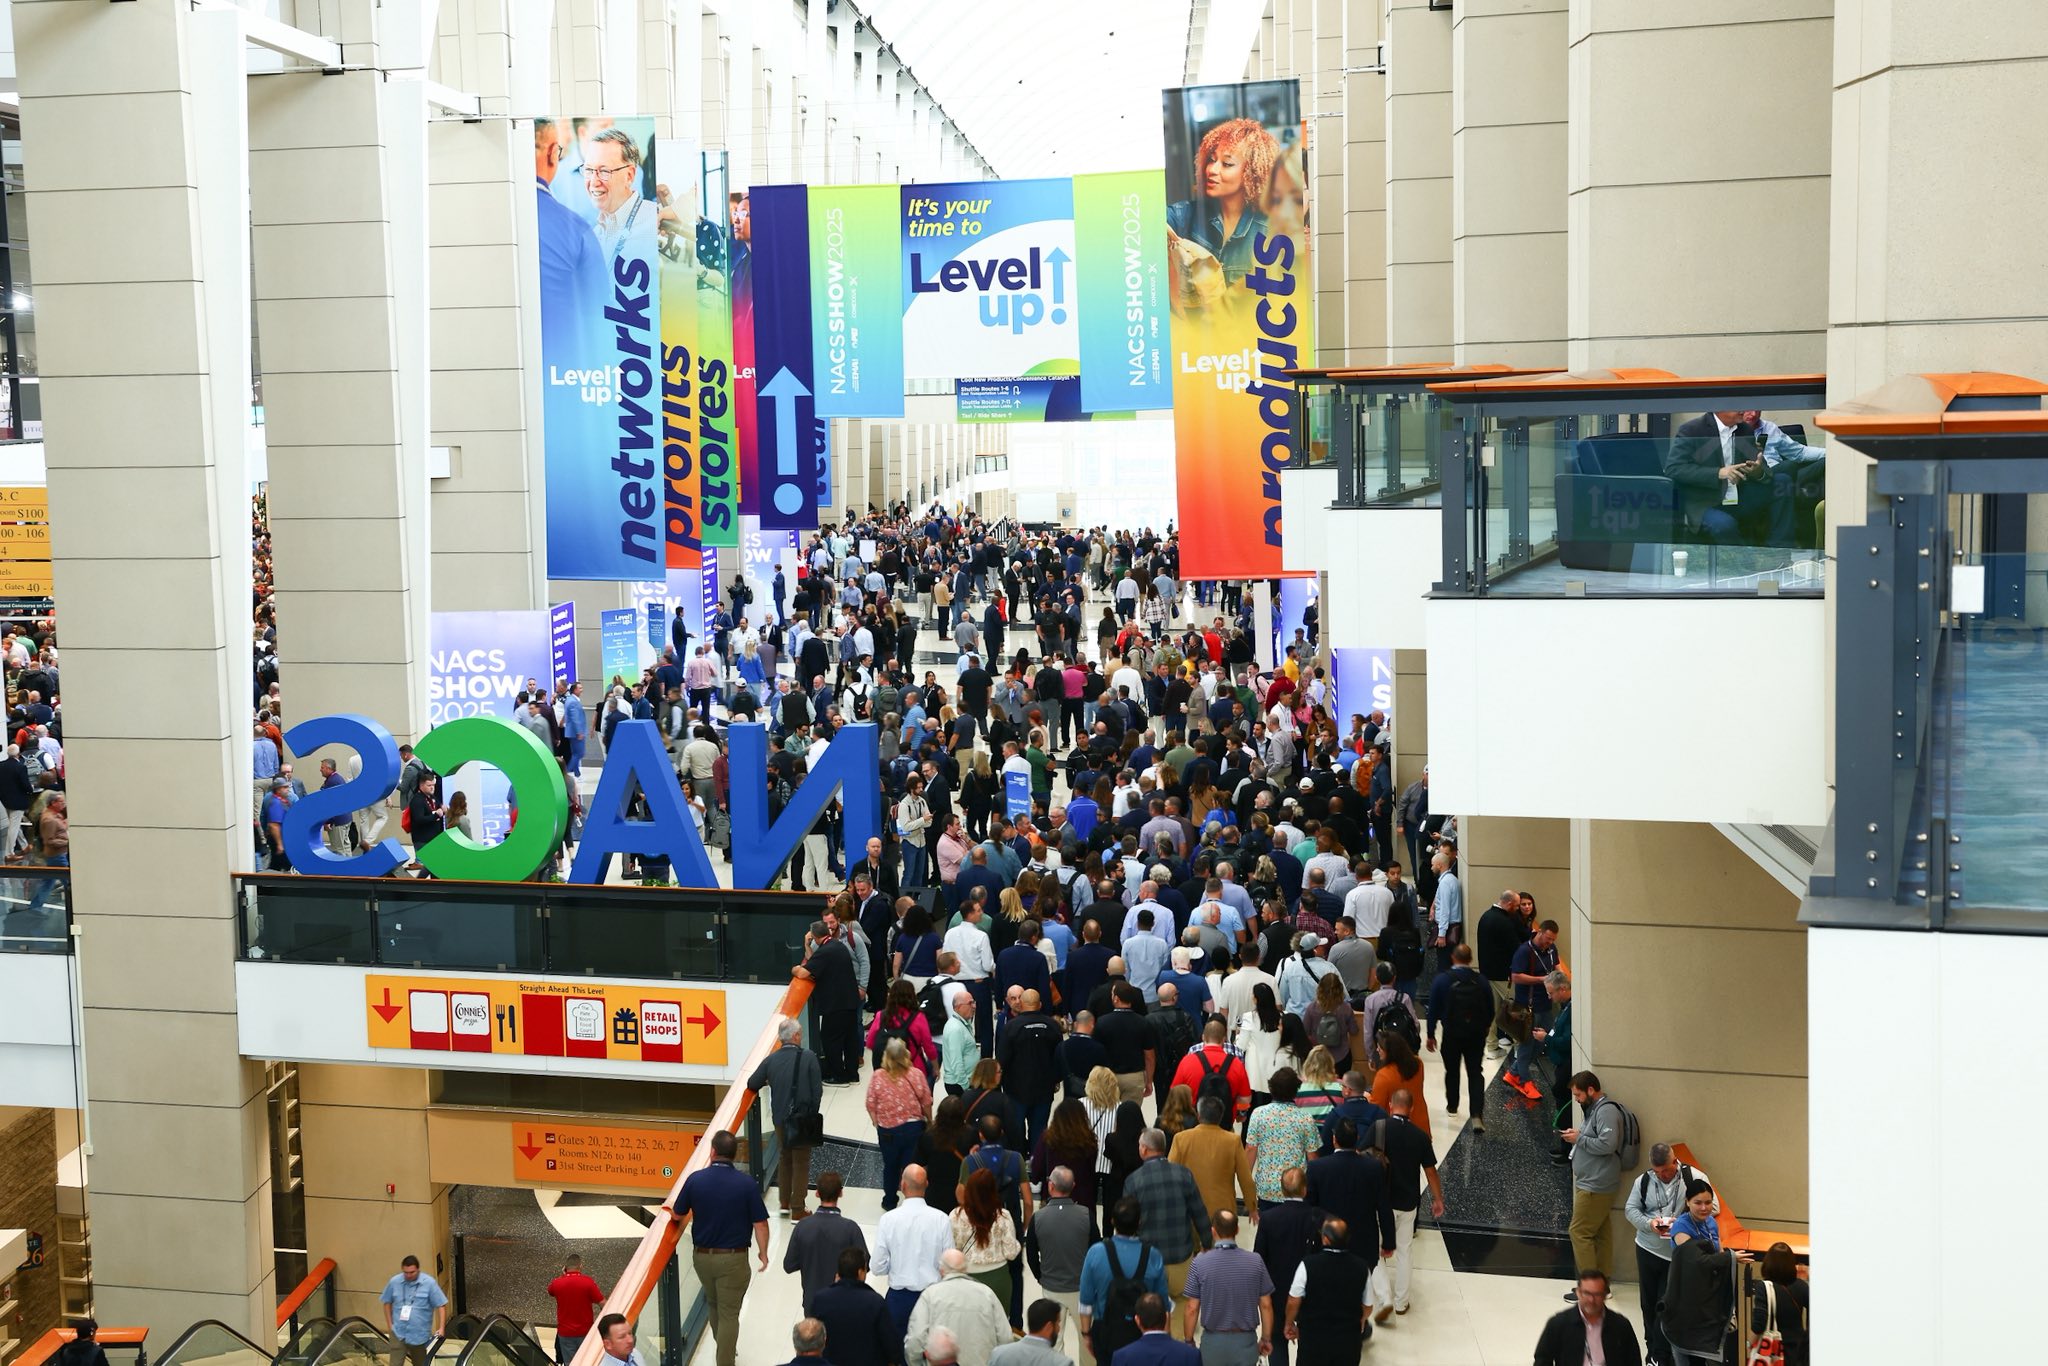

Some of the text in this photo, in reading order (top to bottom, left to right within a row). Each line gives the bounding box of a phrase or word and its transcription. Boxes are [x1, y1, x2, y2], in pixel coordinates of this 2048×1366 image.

[908, 198, 992, 218] It's your
[909, 218, 982, 237] time to
[910, 246, 1041, 293] Level
[1181, 348, 1249, 373] Level
[549, 364, 610, 386] Level
[603, 253, 657, 564] networks
[699, 355, 731, 531] stores
[10, 491, 19, 501] C
[17, 509, 44, 519] S100
[26, 529, 45, 538] 106
[5, 583, 25, 591] Gates
[27, 583, 40, 592] 40
[430, 648, 506, 673] NACS
[430, 675, 524, 699] SHOW
[430, 701, 497, 723] 2025
[519, 984, 605, 995] Straight Ahead This Level
[644, 1011, 677, 1022] RETAIL
[645, 1025, 678, 1035] SHOPS
[558, 1134, 680, 1151] Gates 20, 21, 22, 25, 26, 27
[558, 1148, 642, 1162] Rooms N126 to 140
[558, 1162, 575, 1171] 31st
[577, 1161, 602, 1172] Street
[605, 1162, 639, 1176] Parking
[641, 1165, 656, 1175] Lot
